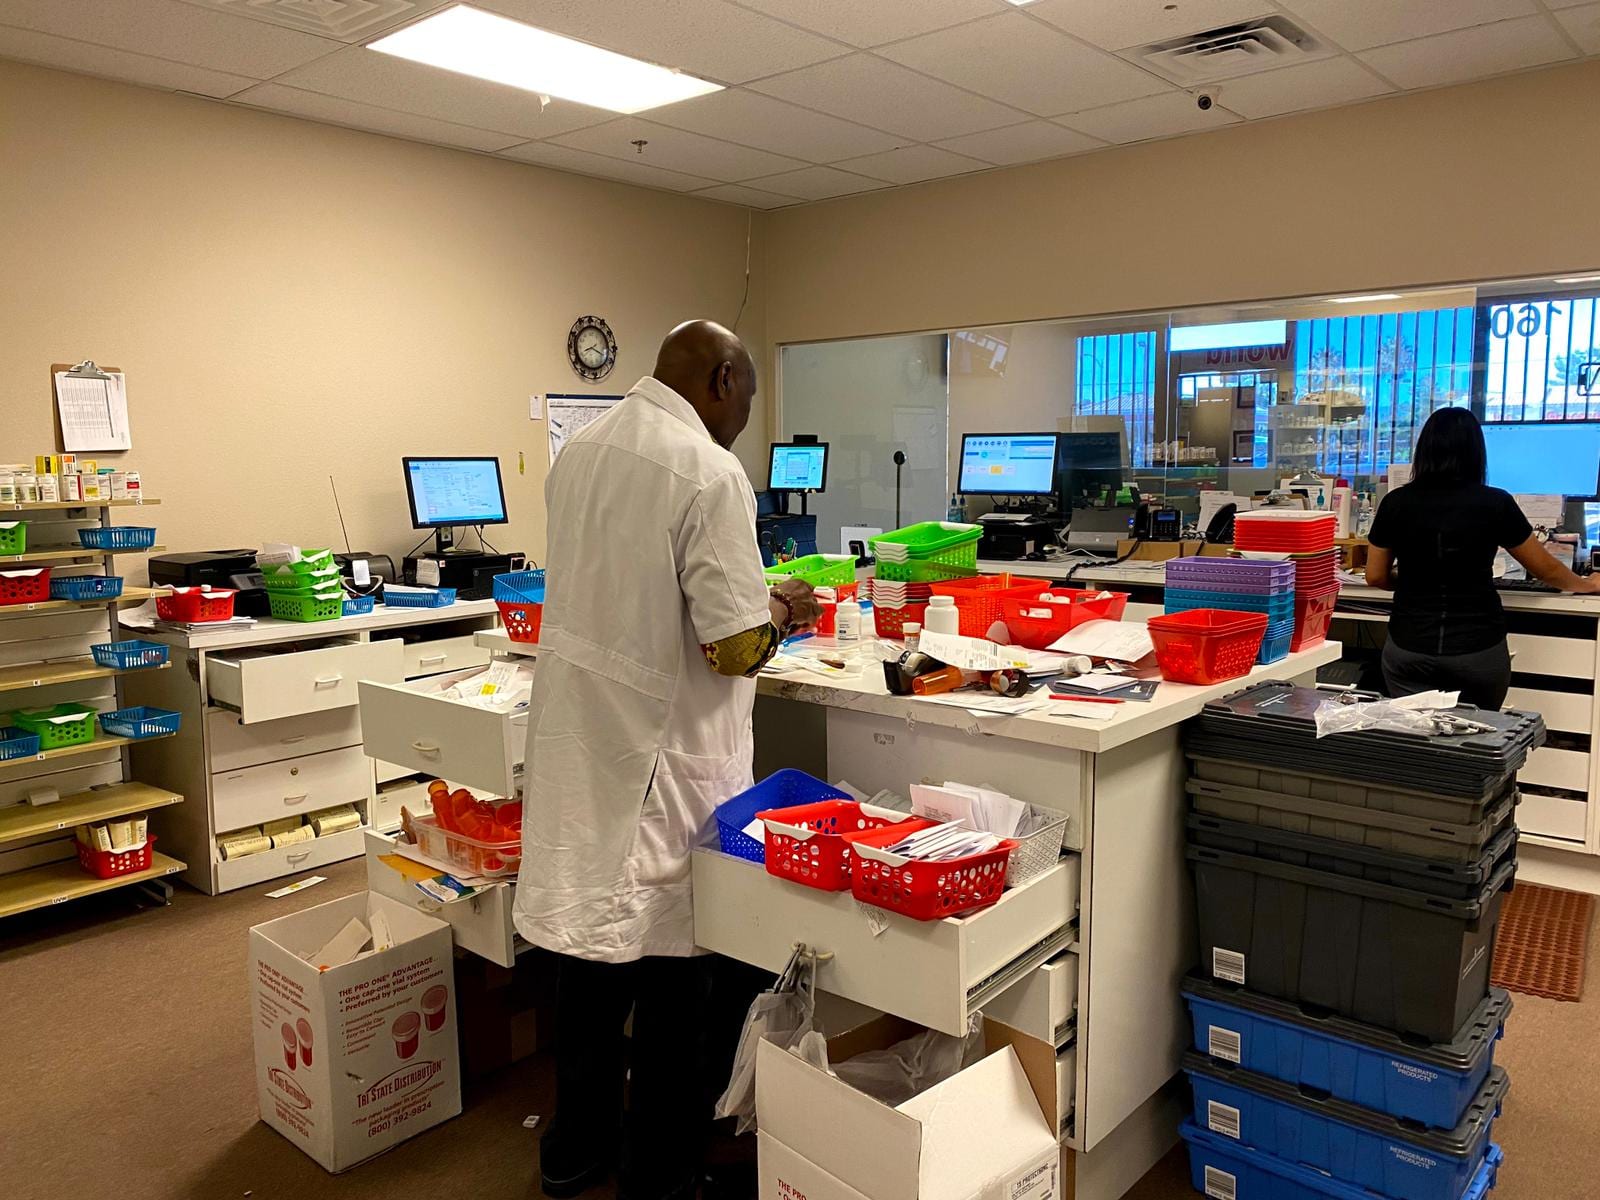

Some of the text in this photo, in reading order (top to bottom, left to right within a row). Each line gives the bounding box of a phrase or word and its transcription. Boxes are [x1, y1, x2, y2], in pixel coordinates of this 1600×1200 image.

[339, 986, 352, 998] THE
[355, 981, 370, 993] PRO
[345, 967, 430, 1004] One cap-one vial system
[345, 970, 443, 1012] Preferred by your customers
[1391, 1060, 1438, 1079] REFRIGERATED
[1397, 1068, 1431, 1082] PRODUCTS
[357, 1093, 369, 1108] TRI
[371, 1082, 392, 1103] STATE
[368, 1101, 432, 1138] (800) 392-9824
[1390, 1146, 1437, 1167] REFRIGERATED
[1396, 1153, 1430, 1169] PRODUCTS
[777, 1178, 790, 1194] THE
[792, 1188, 807, 1200] PRO
